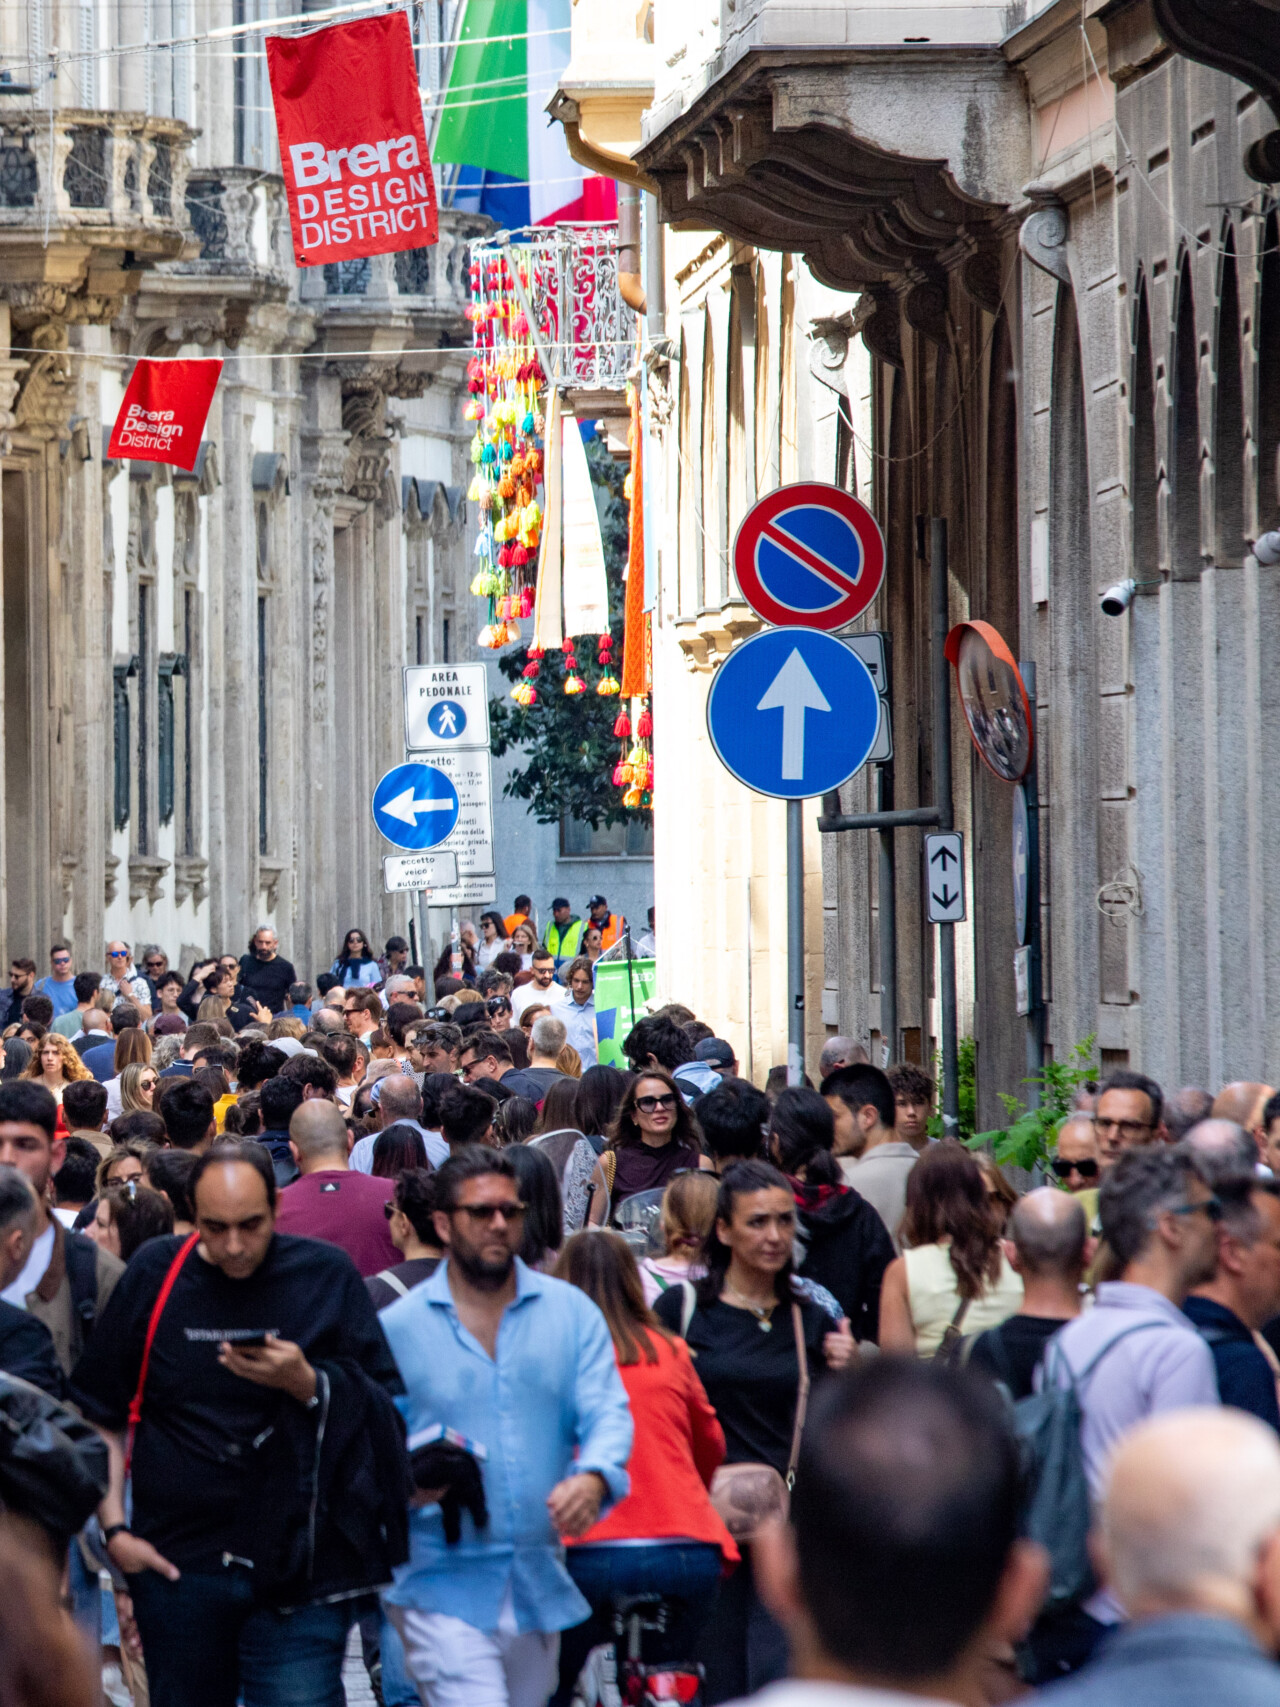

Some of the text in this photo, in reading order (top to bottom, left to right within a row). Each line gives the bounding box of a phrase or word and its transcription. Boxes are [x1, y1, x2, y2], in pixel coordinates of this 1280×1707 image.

[289, 134, 420, 188] Brera
[297, 172, 429, 220] DESIGN
[301, 201, 430, 249] DISTRICT
[127, 403, 175, 422] Brera
[122, 417, 184, 438] Design
[118, 431, 173, 451] District
[431, 671, 459, 682] AREA
[419, 685, 472, 697] PEDONALE
[401, 857, 435, 865] eccetto
